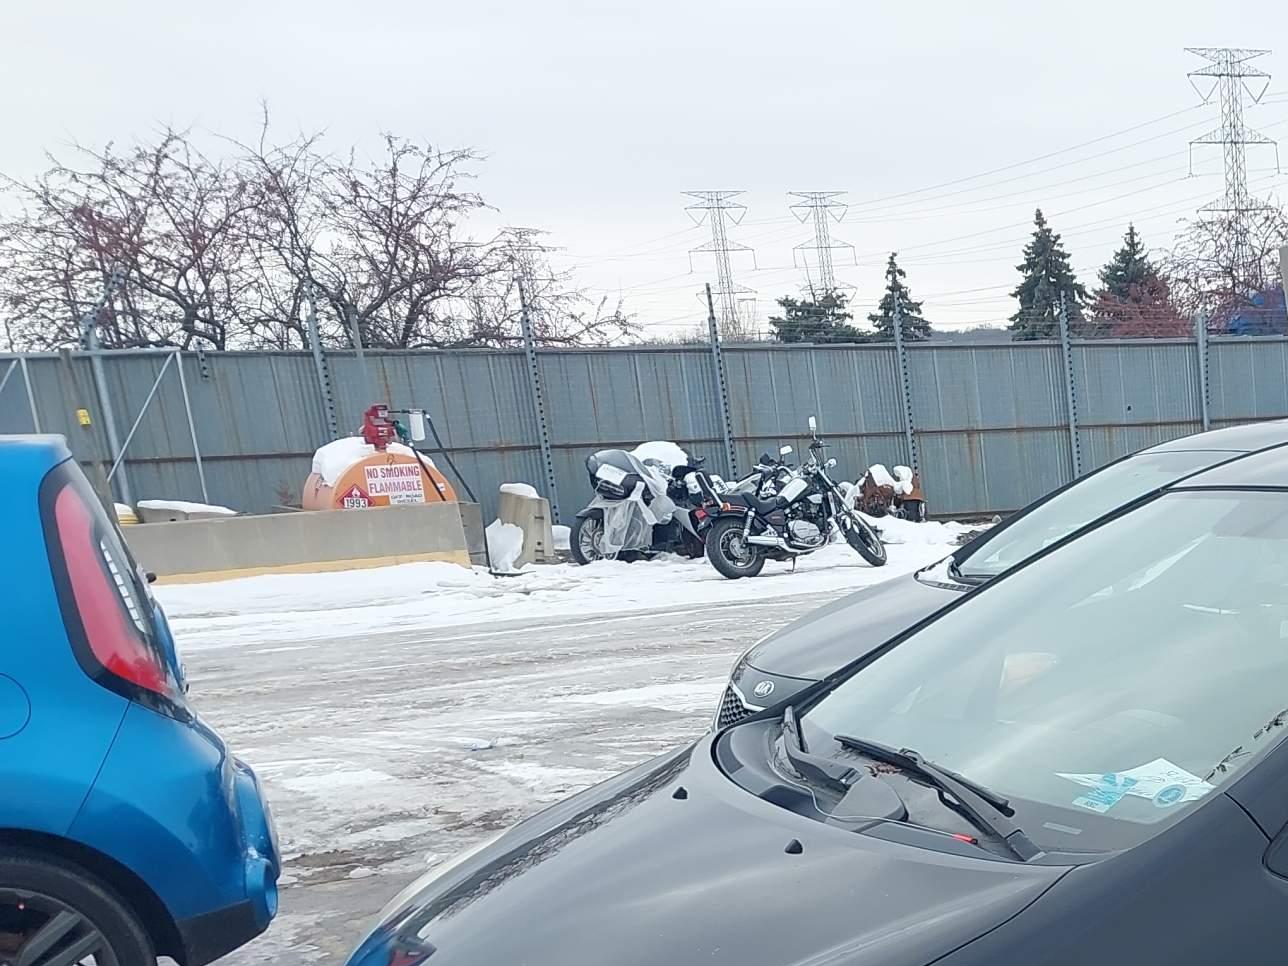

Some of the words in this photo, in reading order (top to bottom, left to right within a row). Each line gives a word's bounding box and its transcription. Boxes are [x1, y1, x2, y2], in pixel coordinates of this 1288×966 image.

[366, 468, 379, 479] NO
[380, 466, 420, 479] SMOKING
[369, 481, 422, 493] FLAMMABLE
[345, 499, 366, 508] 1993
